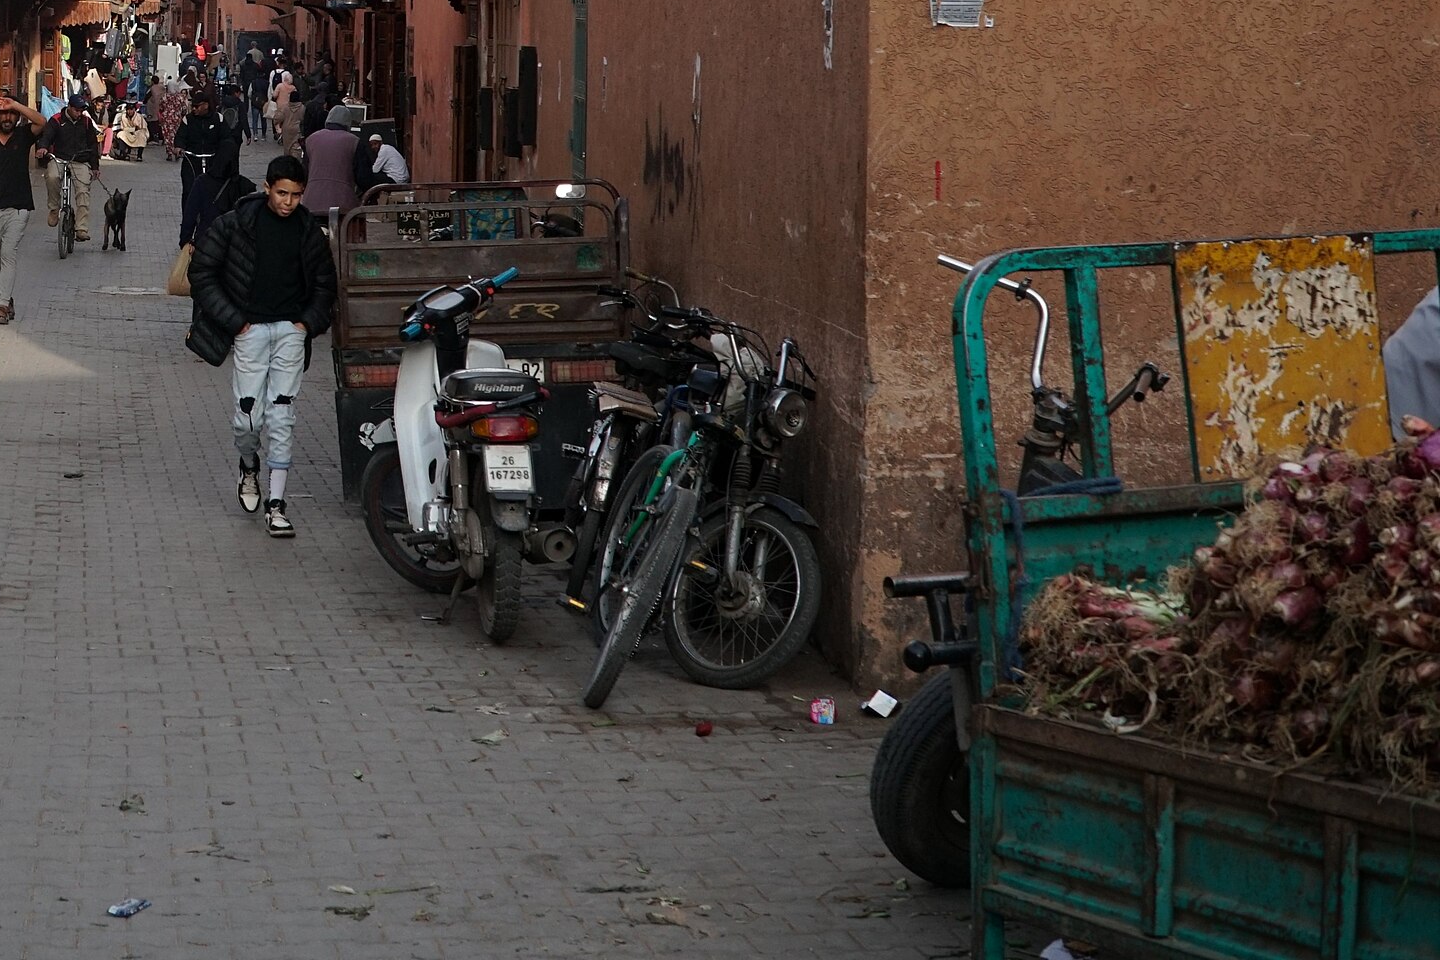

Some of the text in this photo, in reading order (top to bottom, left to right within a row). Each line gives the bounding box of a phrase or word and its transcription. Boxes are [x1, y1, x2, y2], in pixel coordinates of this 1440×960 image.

[473, 383, 525, 394] Highland
[501, 456, 515, 465] 26
[489, 470, 530, 480] 167298
